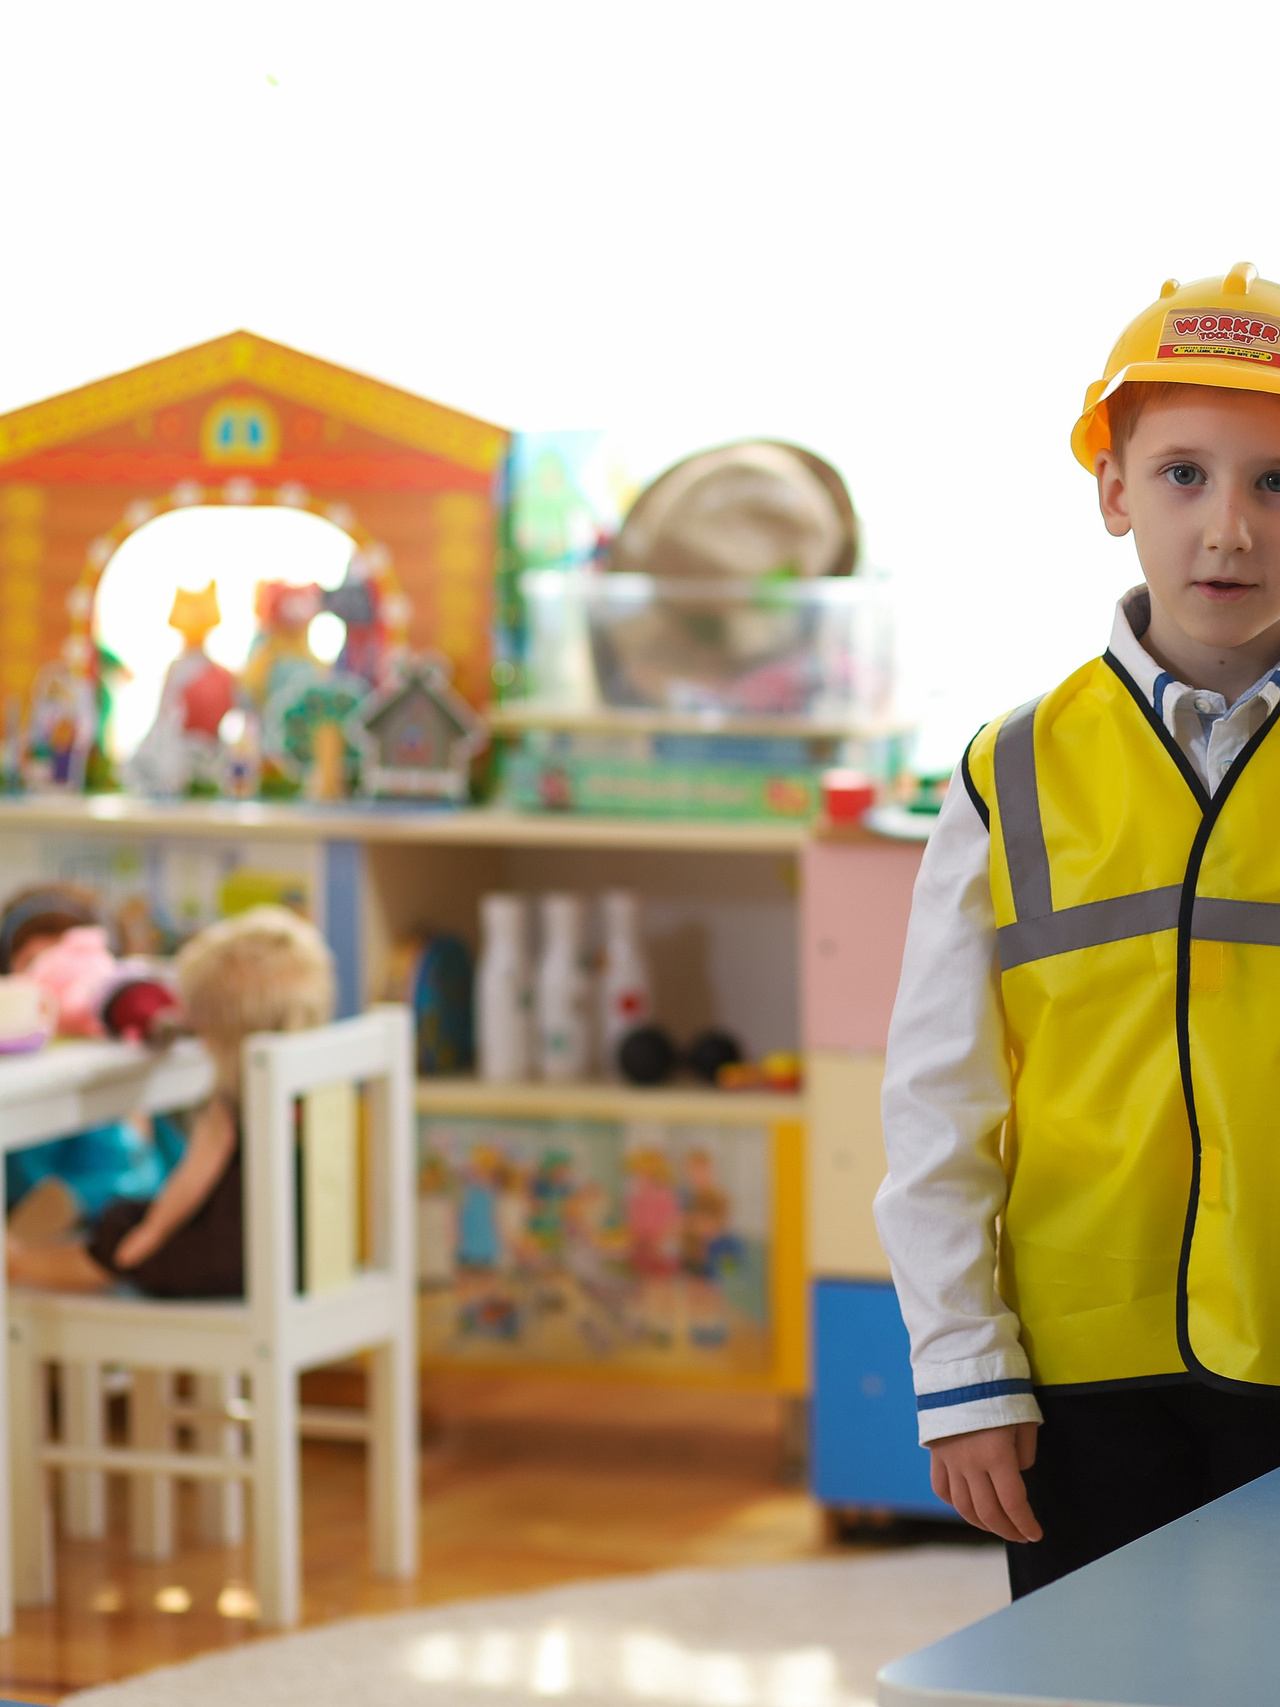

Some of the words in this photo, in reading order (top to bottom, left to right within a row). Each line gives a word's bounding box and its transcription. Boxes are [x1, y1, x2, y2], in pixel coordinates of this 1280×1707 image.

[1174, 315, 1280, 344] WORKER
[1199, 331, 1230, 340] TOOL
[1232, 333, 1254, 344] SET
